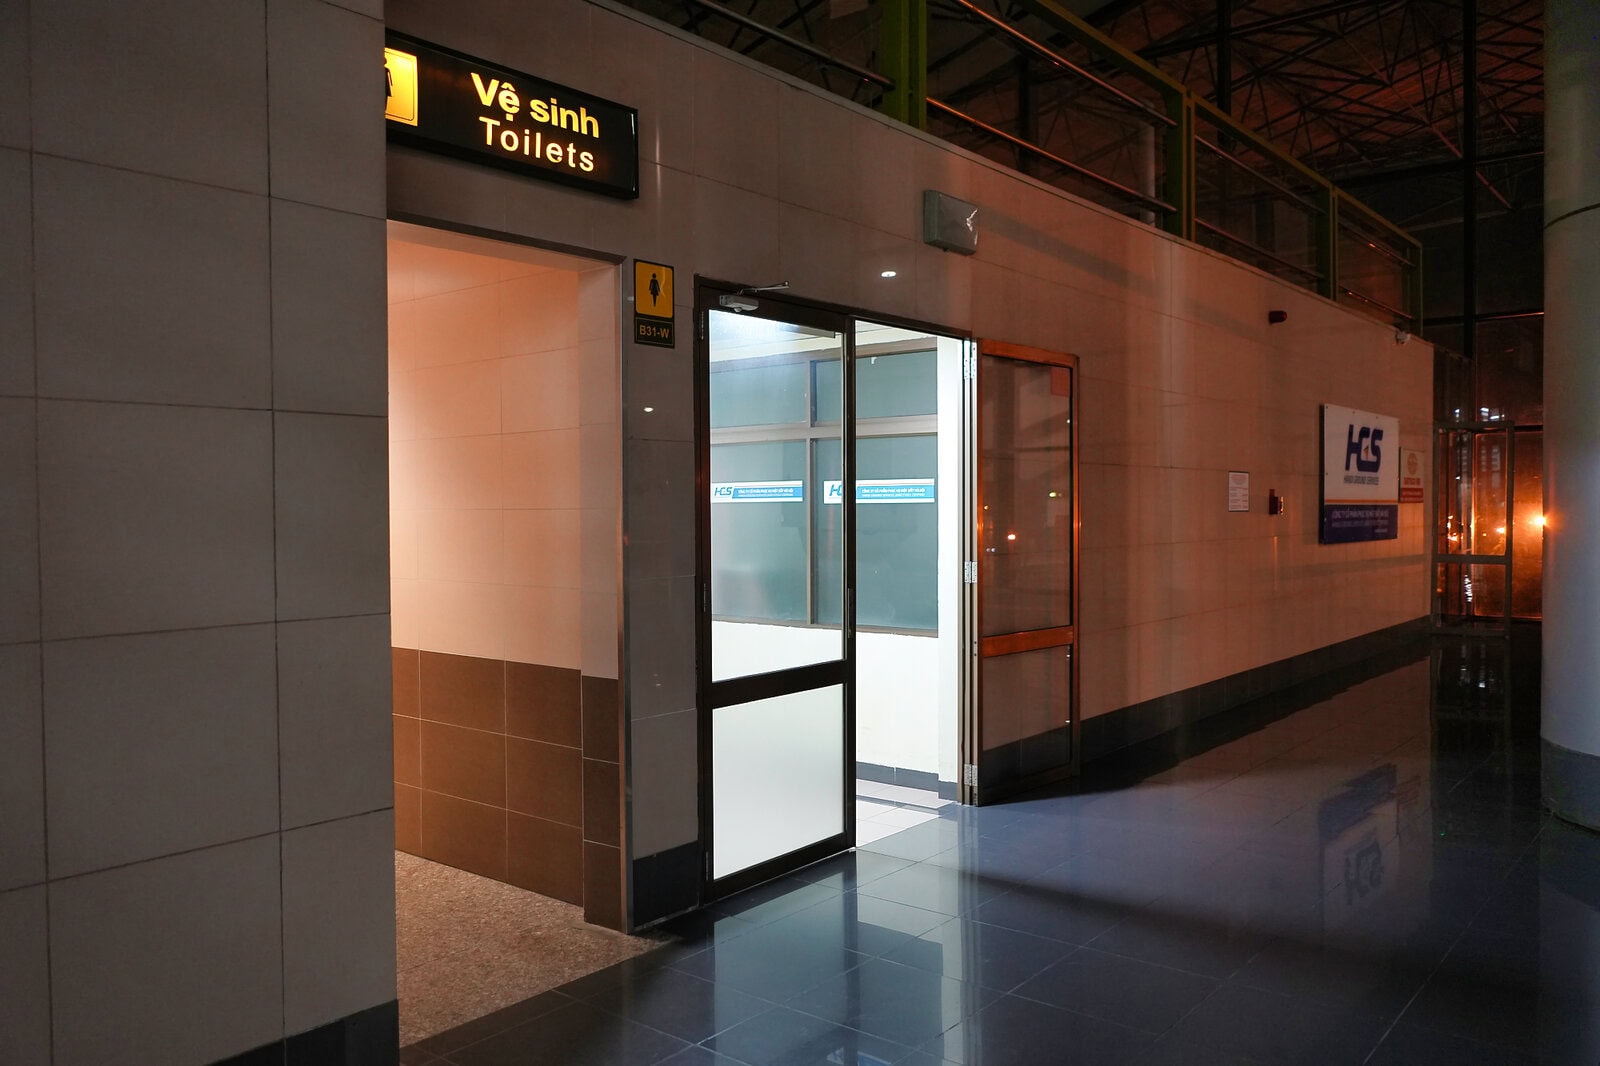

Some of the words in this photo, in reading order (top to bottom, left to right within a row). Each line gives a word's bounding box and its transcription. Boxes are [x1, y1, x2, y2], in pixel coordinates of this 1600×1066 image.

[470, 72, 520, 122] Vệ
[529, 97, 600, 138] sinh
[478, 116, 594, 172] Toilets
[639, 324, 670, 339] B31-W
